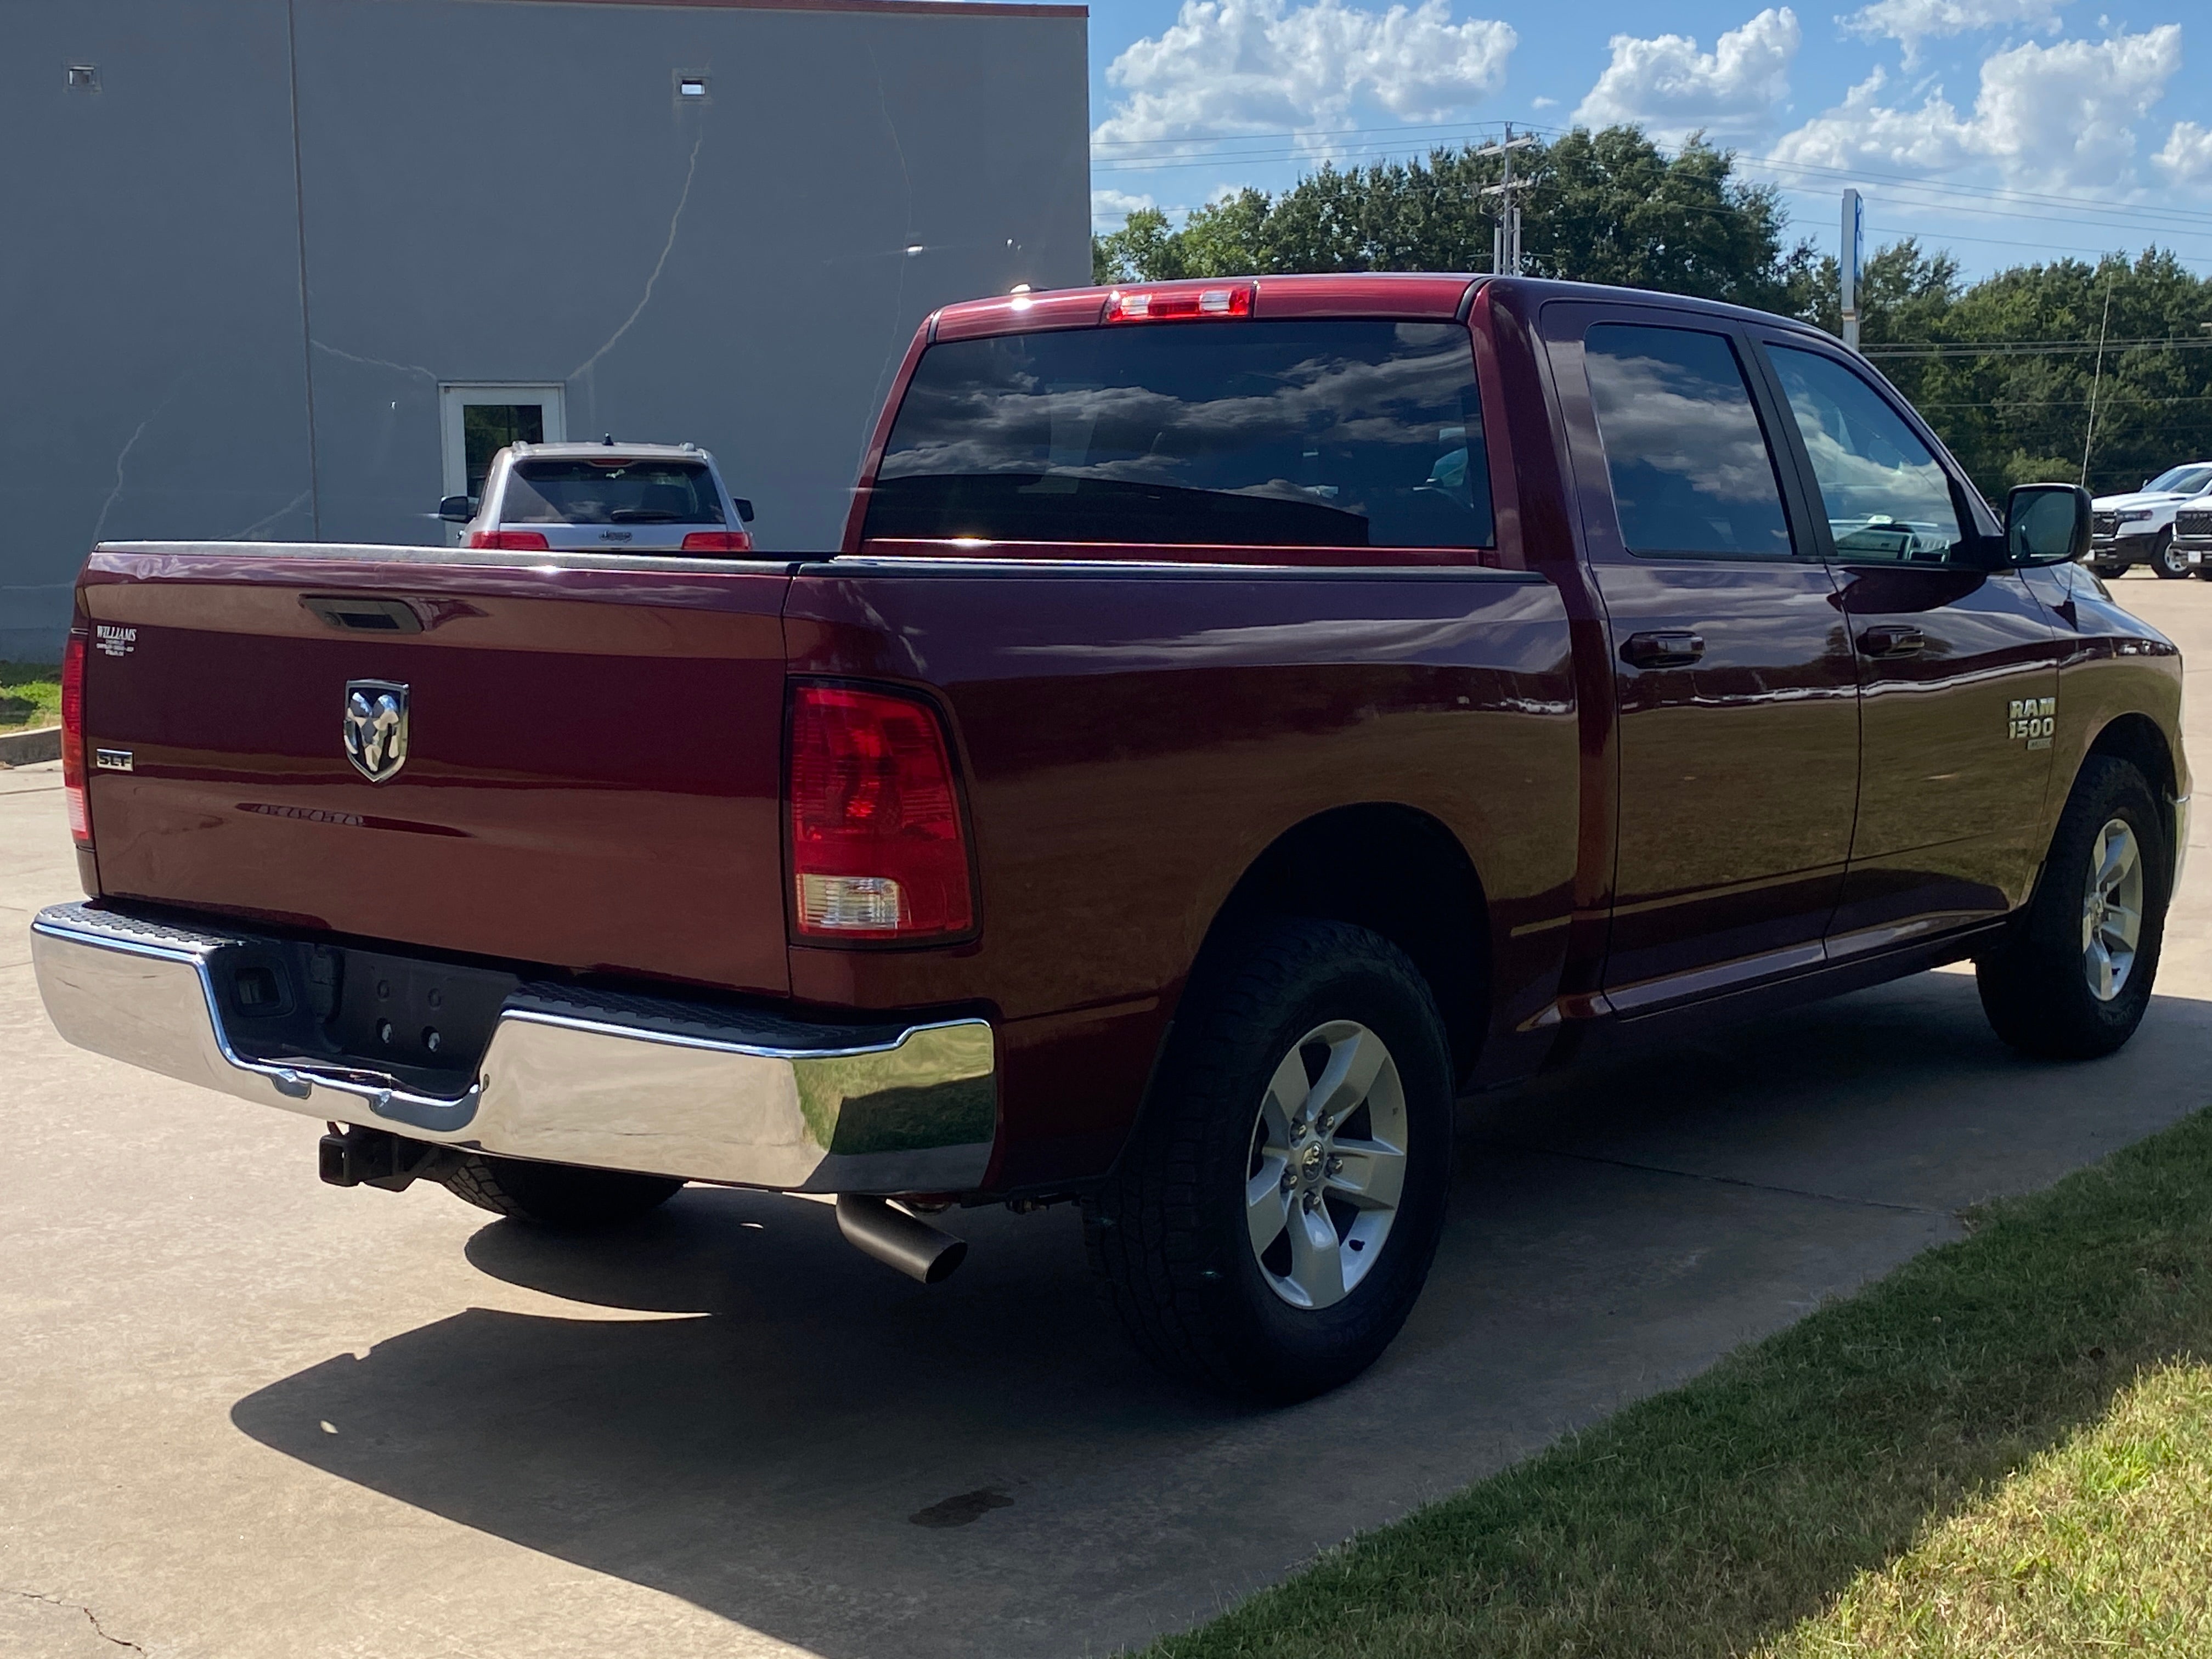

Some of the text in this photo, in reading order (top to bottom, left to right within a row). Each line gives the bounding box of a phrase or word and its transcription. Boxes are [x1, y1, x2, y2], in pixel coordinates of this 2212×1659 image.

[97, 625, 137, 641] WILLIAMS
[2009, 697, 2056, 719] RAM
[2008, 717, 2055, 740] 1500
[99, 753, 131, 767] SLT
